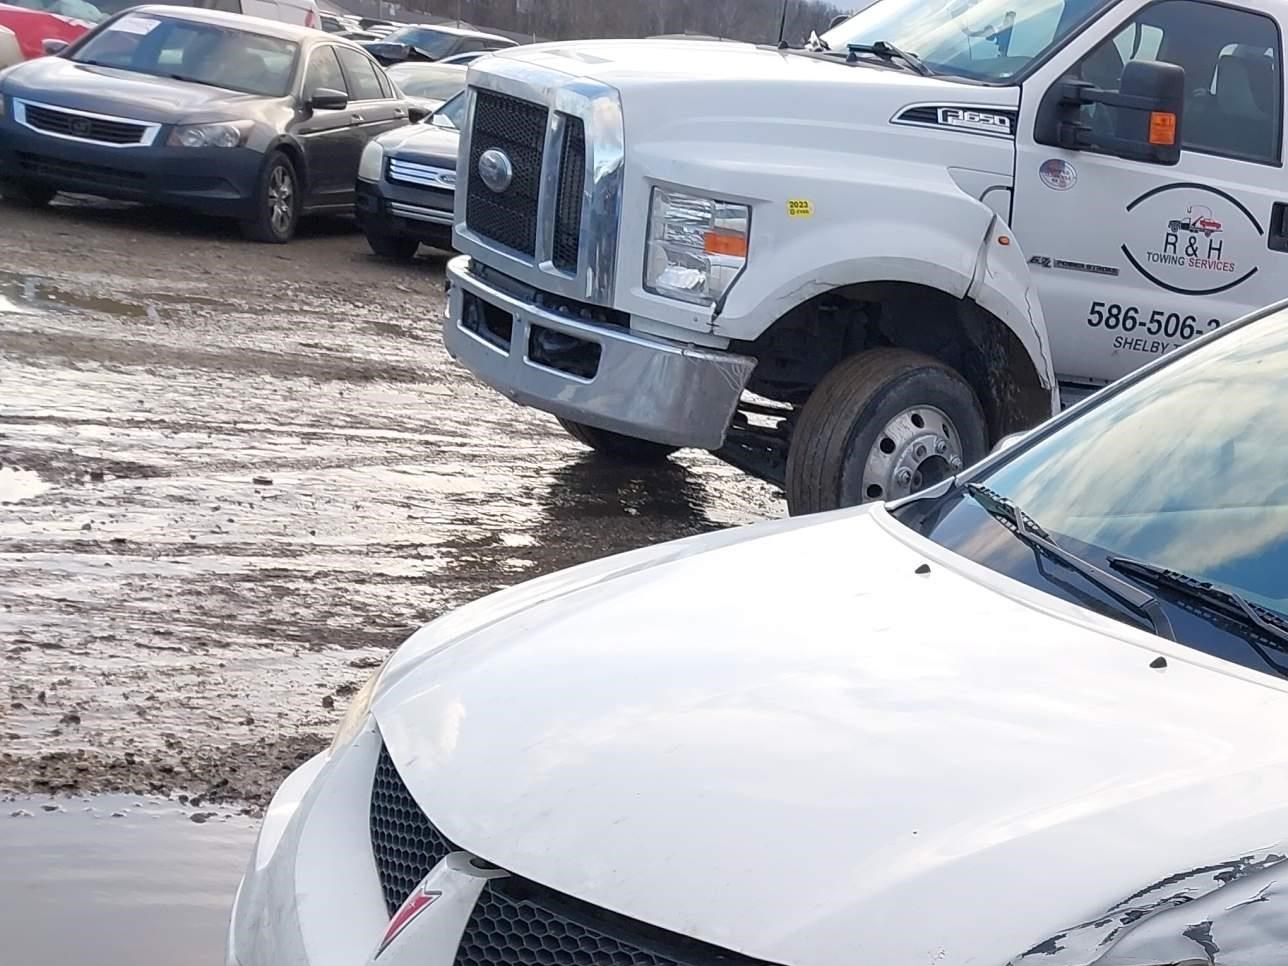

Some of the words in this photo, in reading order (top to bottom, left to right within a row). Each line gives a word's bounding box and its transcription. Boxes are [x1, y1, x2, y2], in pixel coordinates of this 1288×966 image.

[1163, 232, 1179, 254] R
[1185, 236, 1199, 257] &
[1207, 239, 1223, 260] H
[1146, 251, 1185, 266] TOWING
[1188, 257, 1236, 273] SERVICES
[1112, 335, 1169, 354] SHELBY
